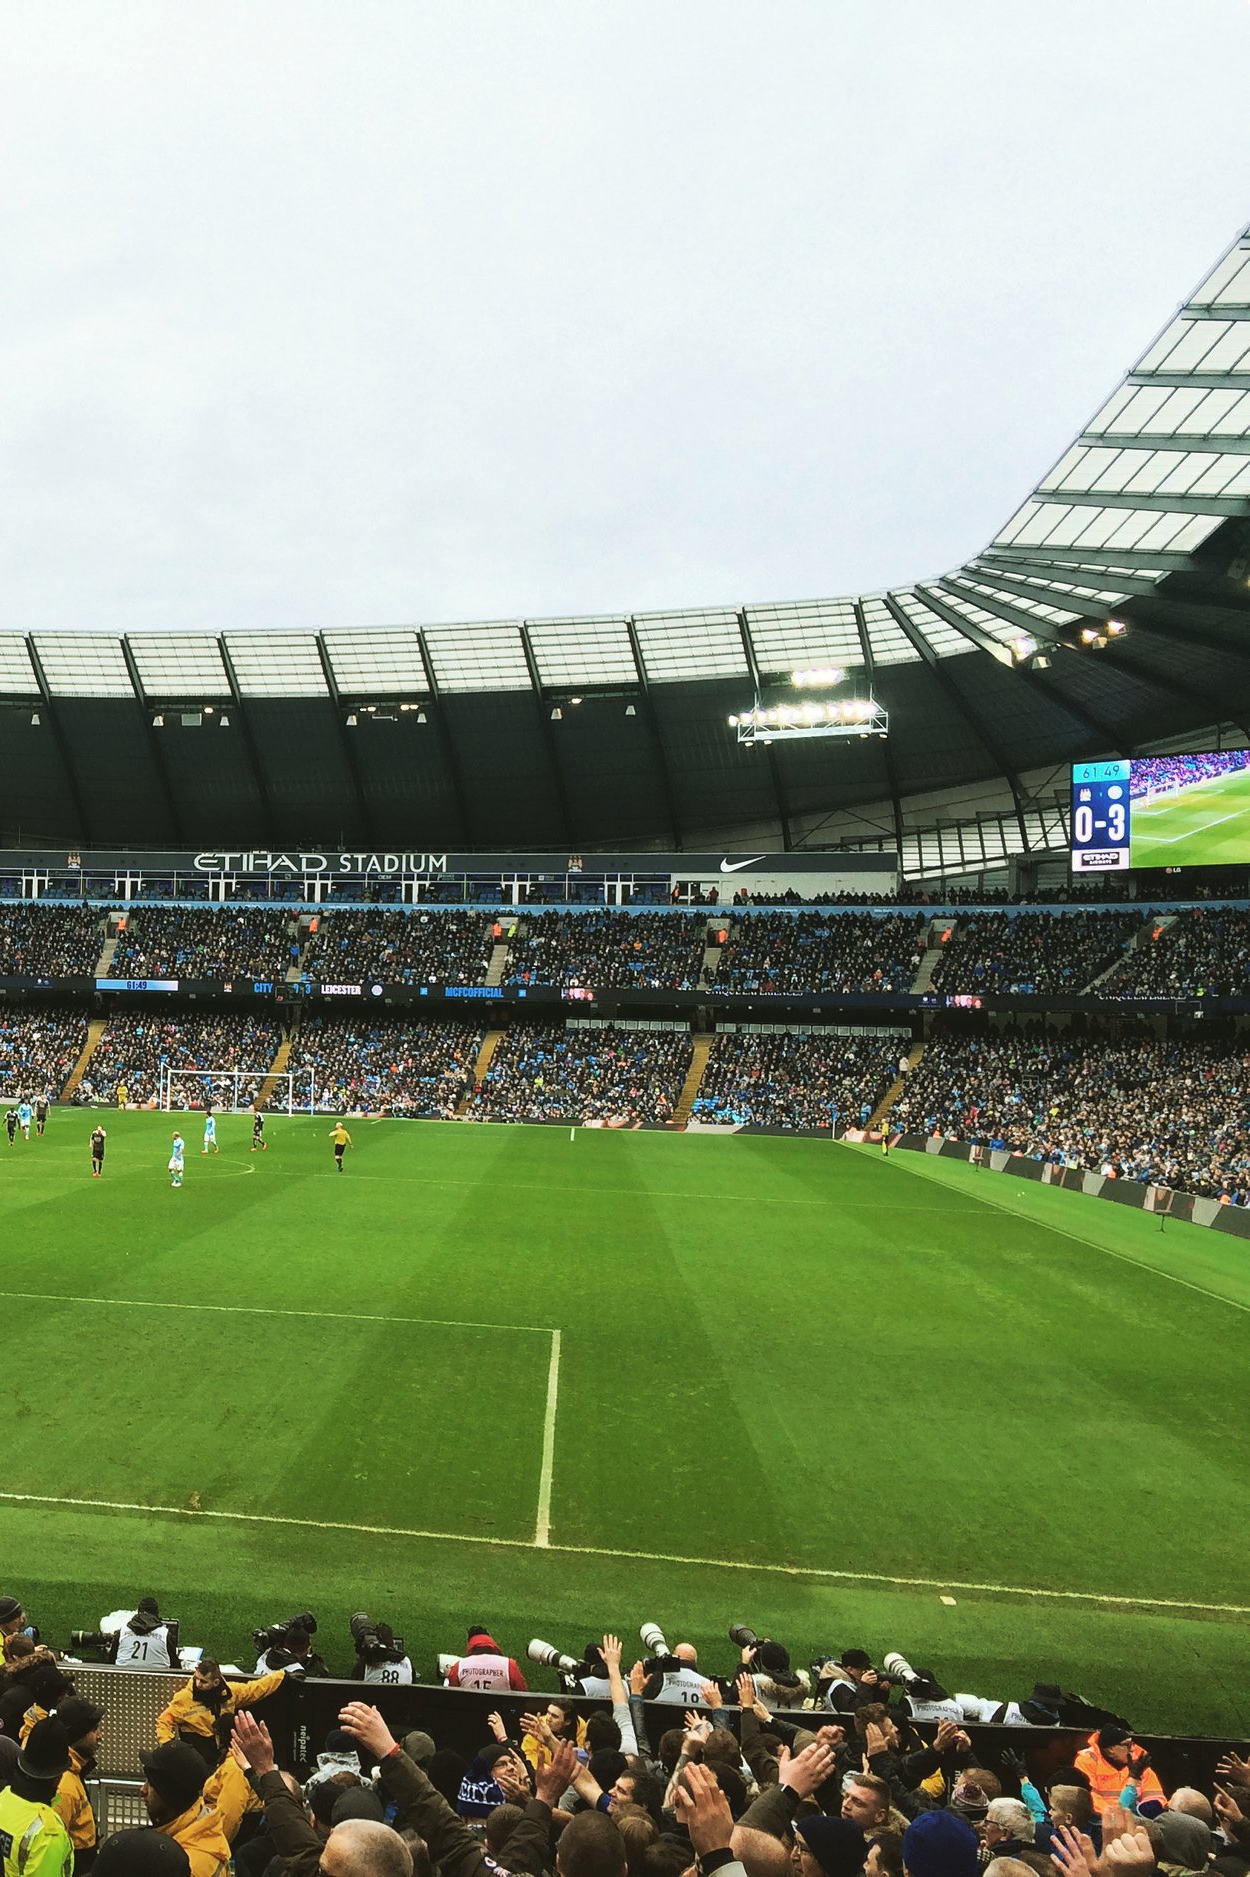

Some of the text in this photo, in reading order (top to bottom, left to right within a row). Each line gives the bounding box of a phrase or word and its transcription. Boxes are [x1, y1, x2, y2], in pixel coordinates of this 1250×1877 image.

[193, 853, 447, 873] ETIHAD STADIUM
[253, 982, 273, 993] CITY
[321, 984, 361, 995] LEICESTER
[131, 1640, 148, 1660] 21
[381, 1669, 399, 1683] 88
[462, 1667, 504, 1677] PHOTOGRAPHER
[681, 1691, 699, 1703] 10
